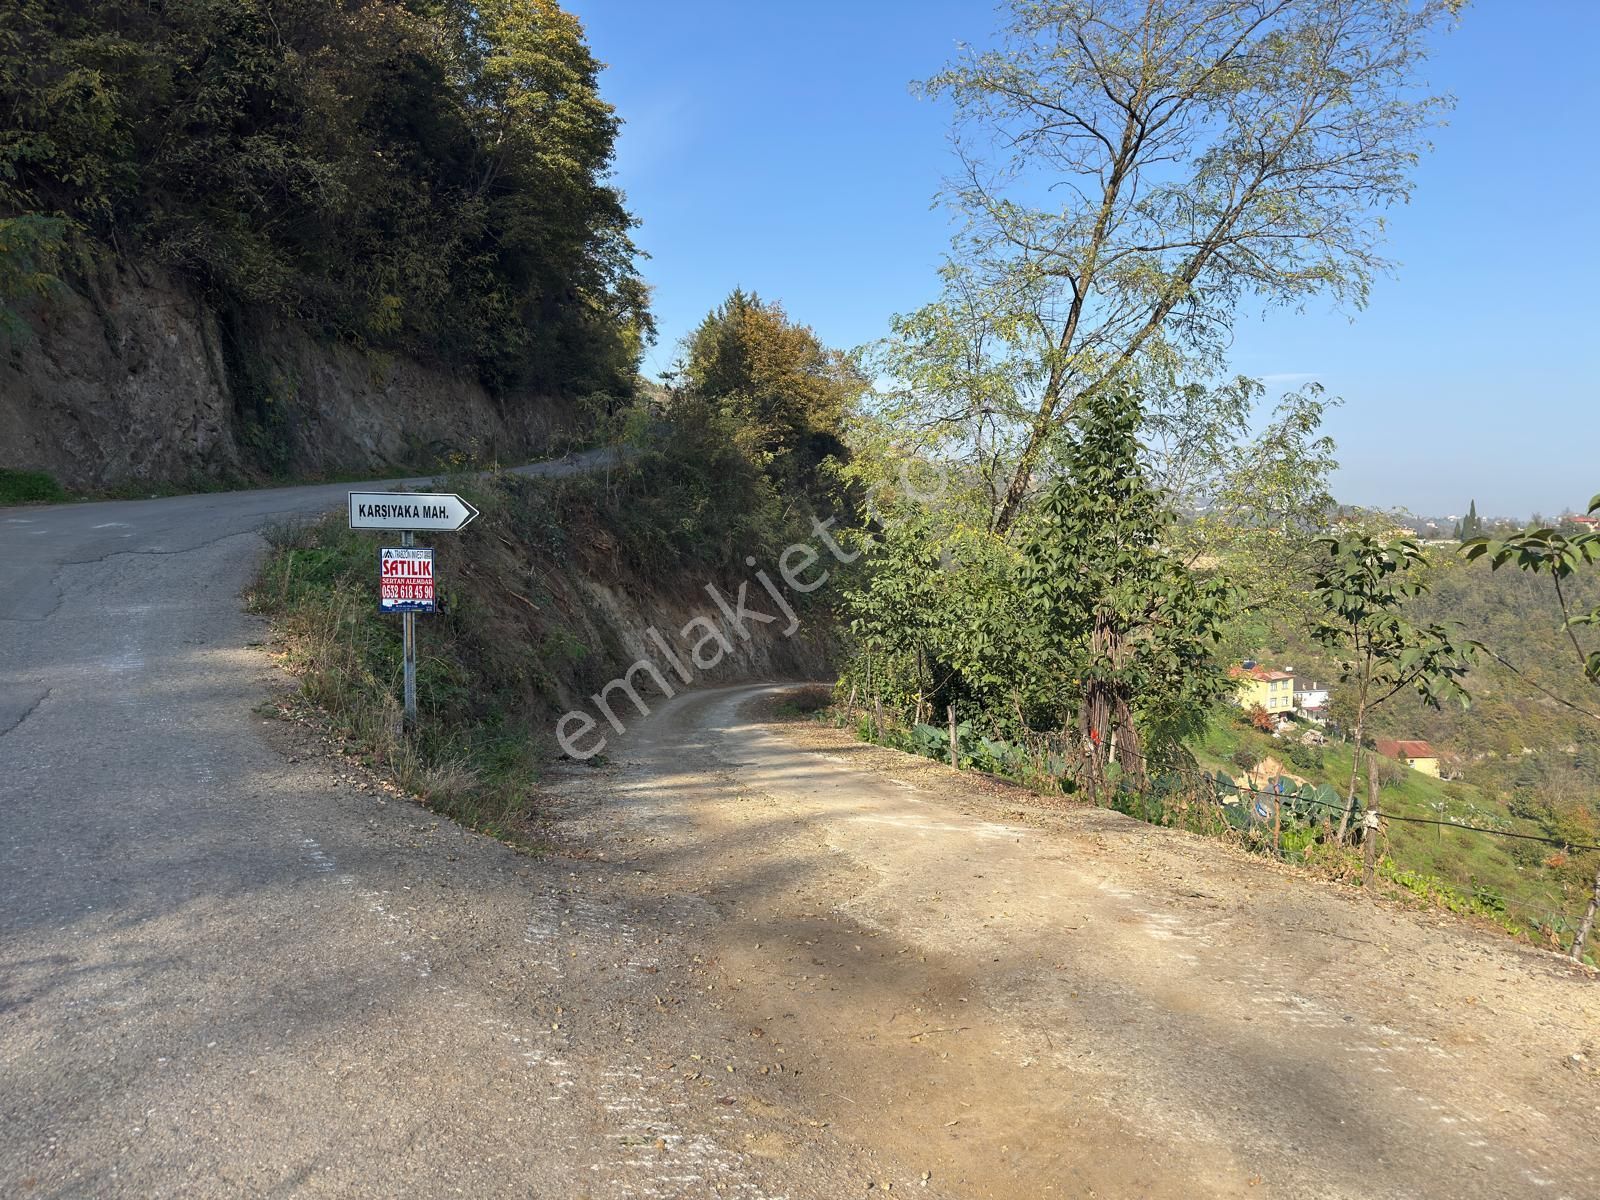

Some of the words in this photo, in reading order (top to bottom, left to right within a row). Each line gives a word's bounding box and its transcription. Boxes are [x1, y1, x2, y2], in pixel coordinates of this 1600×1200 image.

[359, 504, 420, 520] KARŞIYAKA
[422, 505, 449, 519] MAH.
[383, 559, 431, 576] SATILIK
[400, 585, 413, 598] 618
[424, 585, 433, 599] 90
